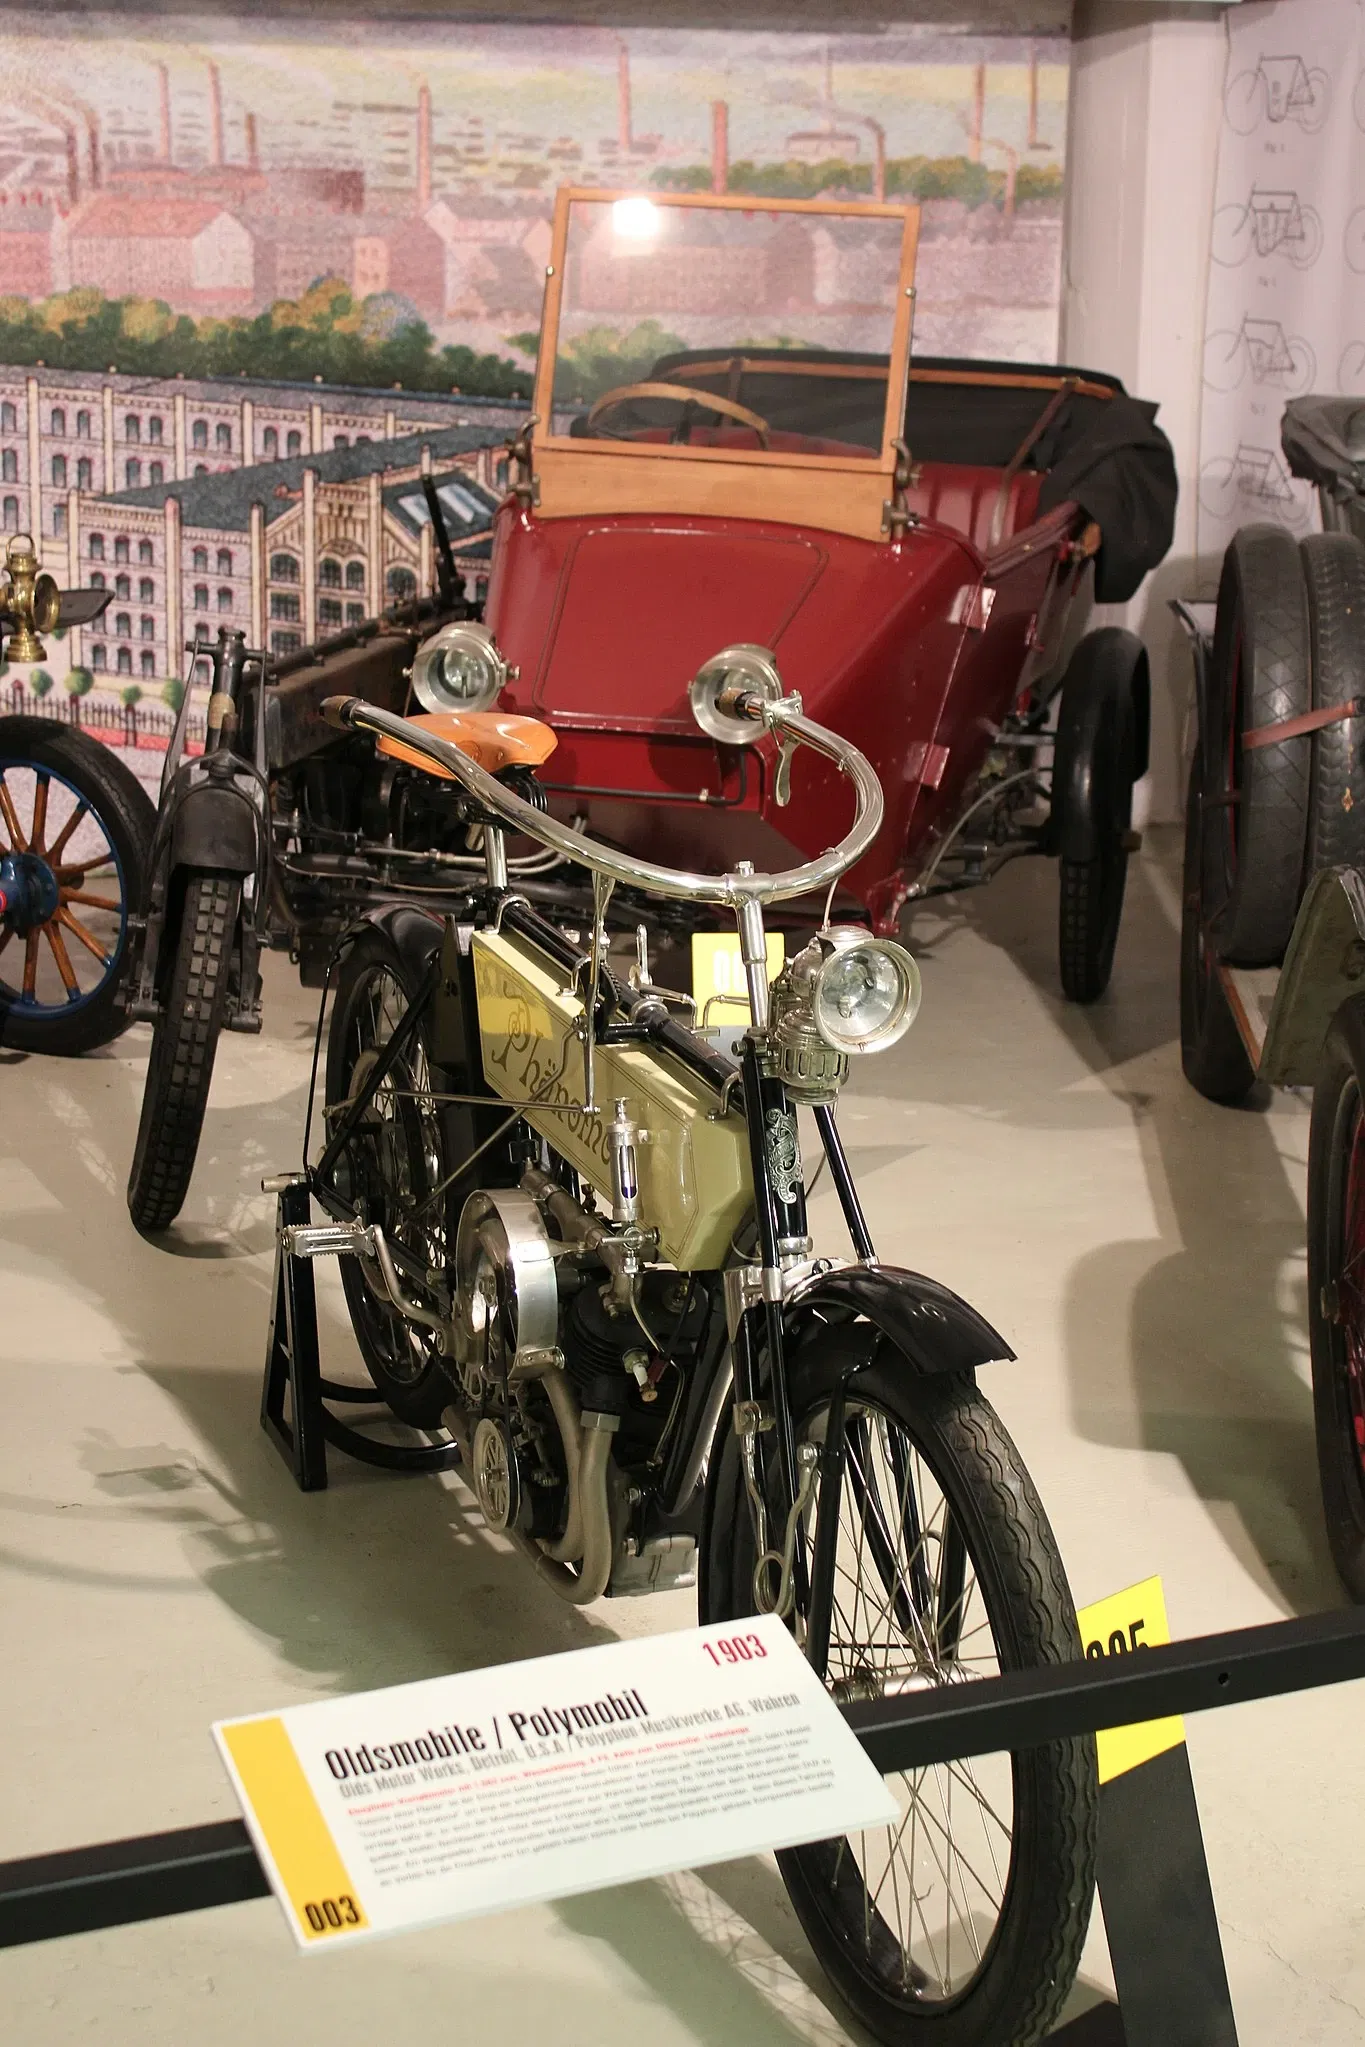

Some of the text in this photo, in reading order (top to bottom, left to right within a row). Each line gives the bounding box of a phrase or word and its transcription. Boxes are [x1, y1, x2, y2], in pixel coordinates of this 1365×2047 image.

[703, 1634, 767, 1667] 1903
[324, 1724, 486, 1781] Oldsmobile
[492, 1715, 503, 1750] /
[508, 1688, 649, 1742] Polymobil
[339, 1782, 373, 1799] Olds
[374, 1771, 417, 1791] Motor
[748, 1692, 801, 1713] Wahren
[304, 1894, 360, 1932] 003
